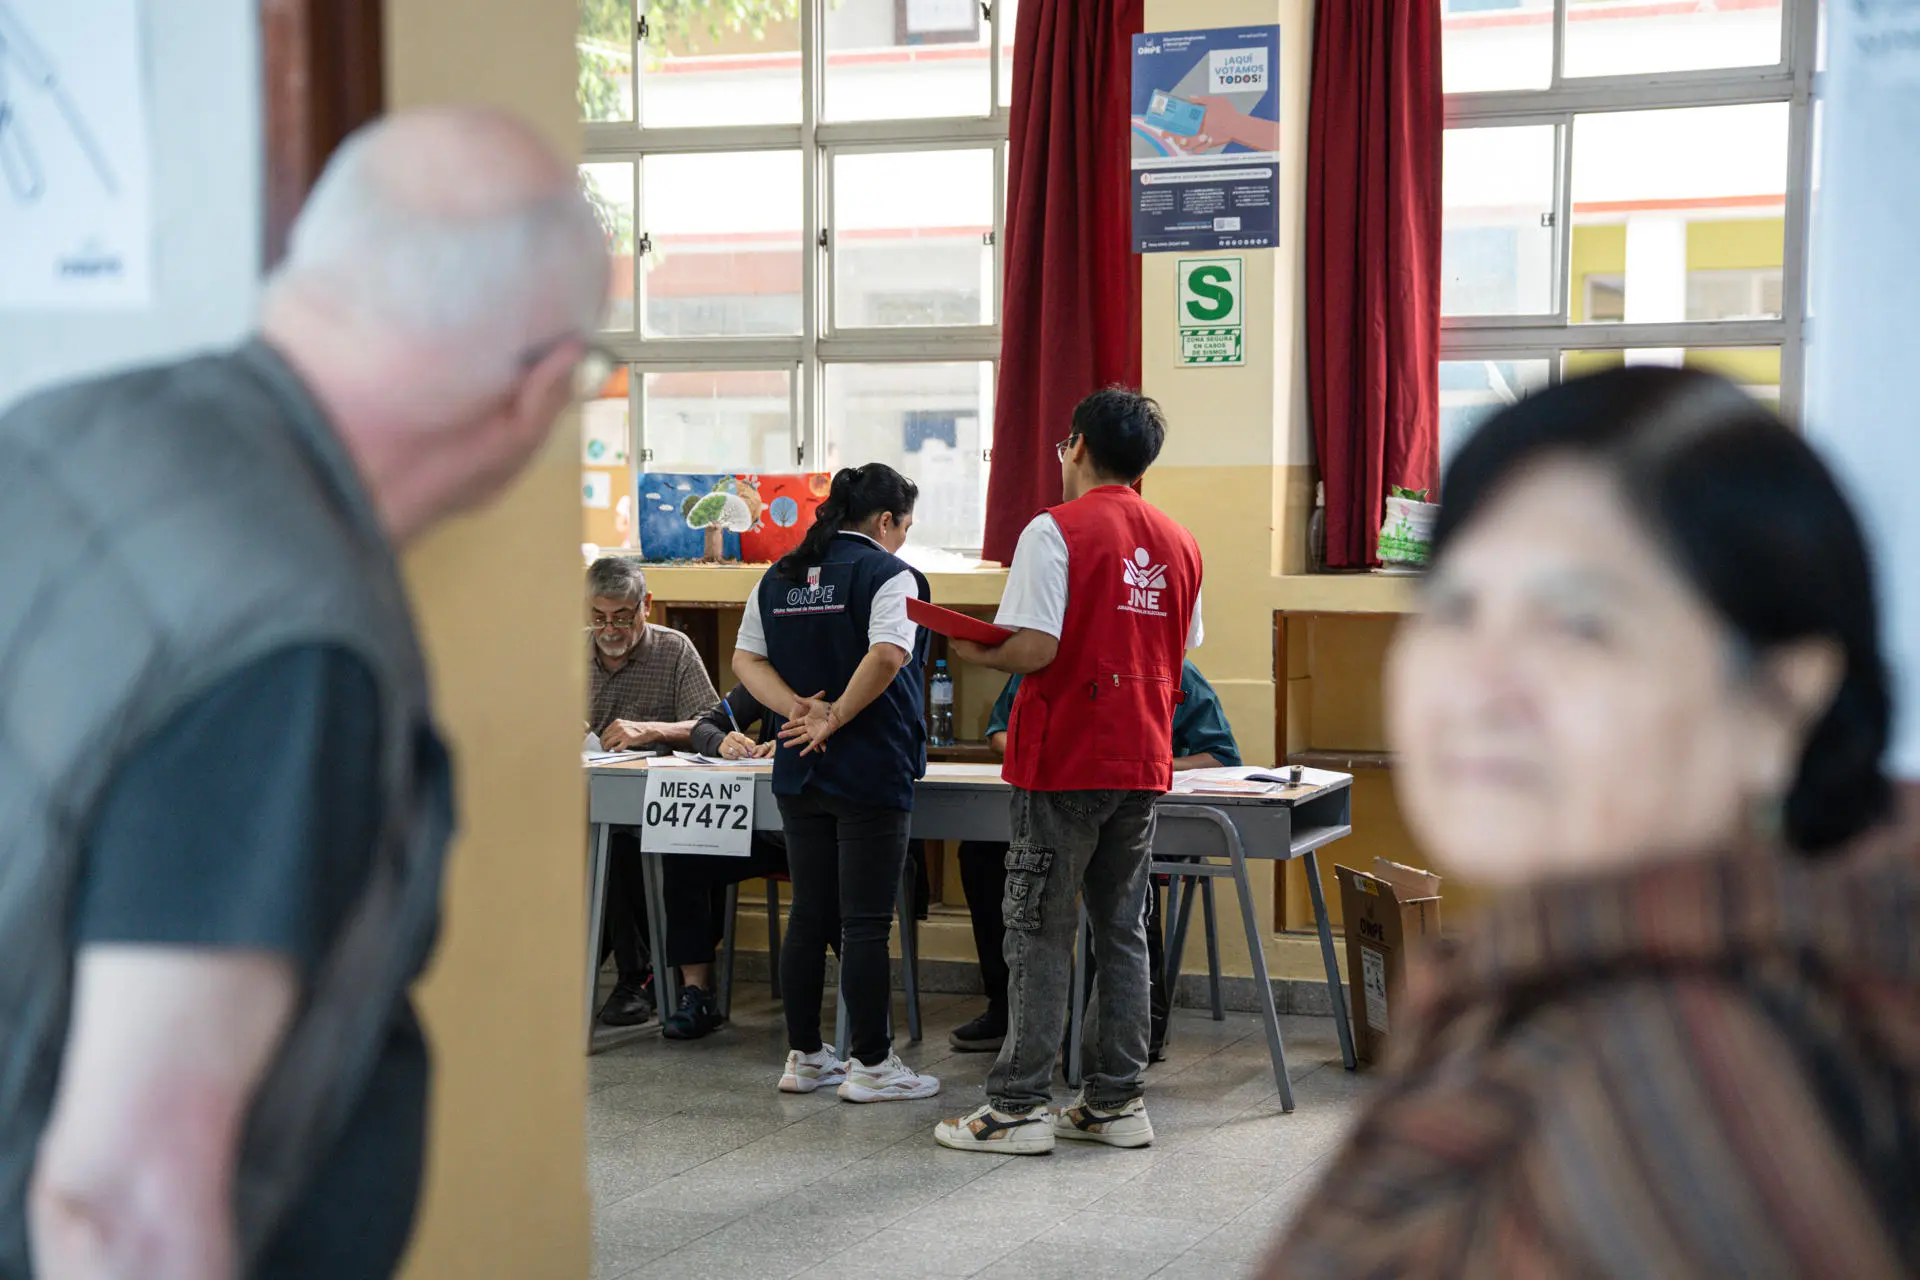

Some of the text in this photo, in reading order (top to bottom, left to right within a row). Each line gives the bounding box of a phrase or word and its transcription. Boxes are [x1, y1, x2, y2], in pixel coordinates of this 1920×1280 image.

[1224, 53, 1253, 66] ¡AQUÍ
[1215, 64, 1264, 75] VOTAMOS
[1219, 74, 1262, 85] TODOS!
[1186, 265, 1234, 321] S
[787, 585, 834, 605] ONPE
[1127, 587, 1161, 610] JNE
[660, 781, 714, 799] MESA
[646, 801, 749, 830] 047472
